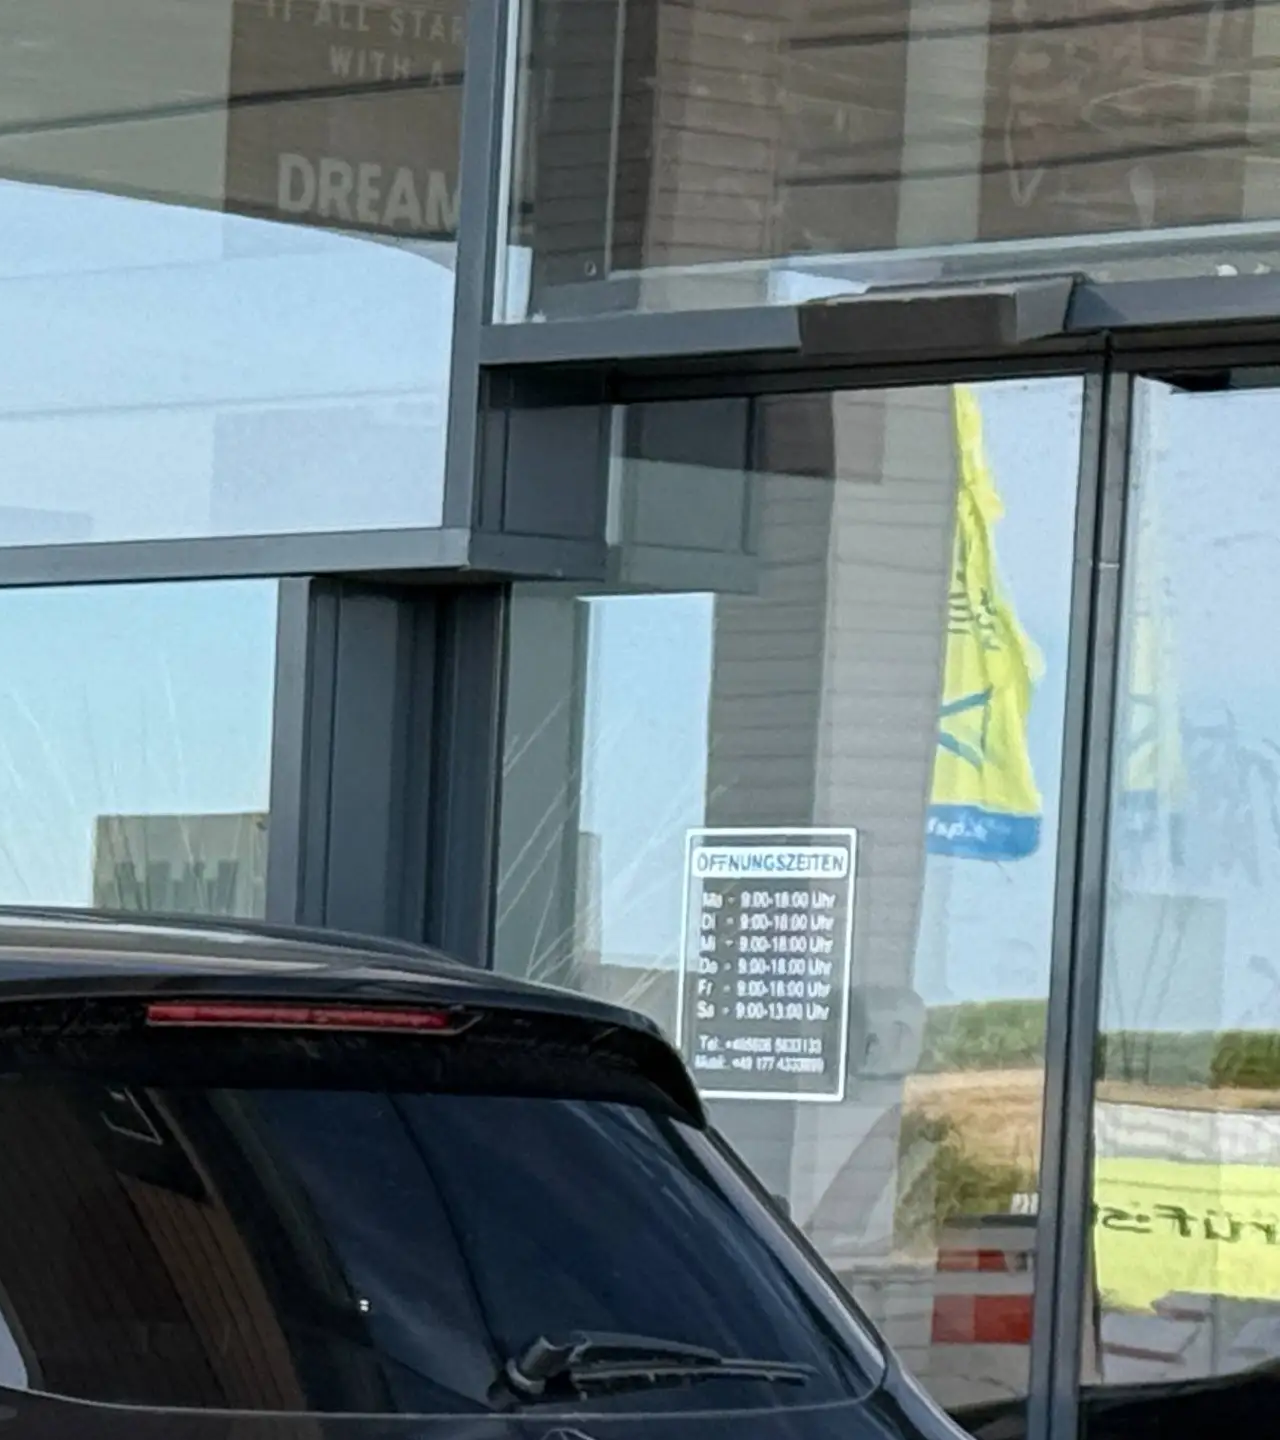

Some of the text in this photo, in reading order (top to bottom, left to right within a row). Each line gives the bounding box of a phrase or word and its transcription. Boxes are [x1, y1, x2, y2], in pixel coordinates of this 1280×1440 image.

[312, 0, 370, 31] ALL
[329, 46, 412, 81] WITH
[811, 891, 835, 909] Uhr
[810, 914, 833, 931] Uhr
[809, 936, 833, 953] Uhr
[807, 957, 832, 975] Uhr
[806, 980, 831, 997] Uhr
[806, 1001, 830, 1020] Uhr
